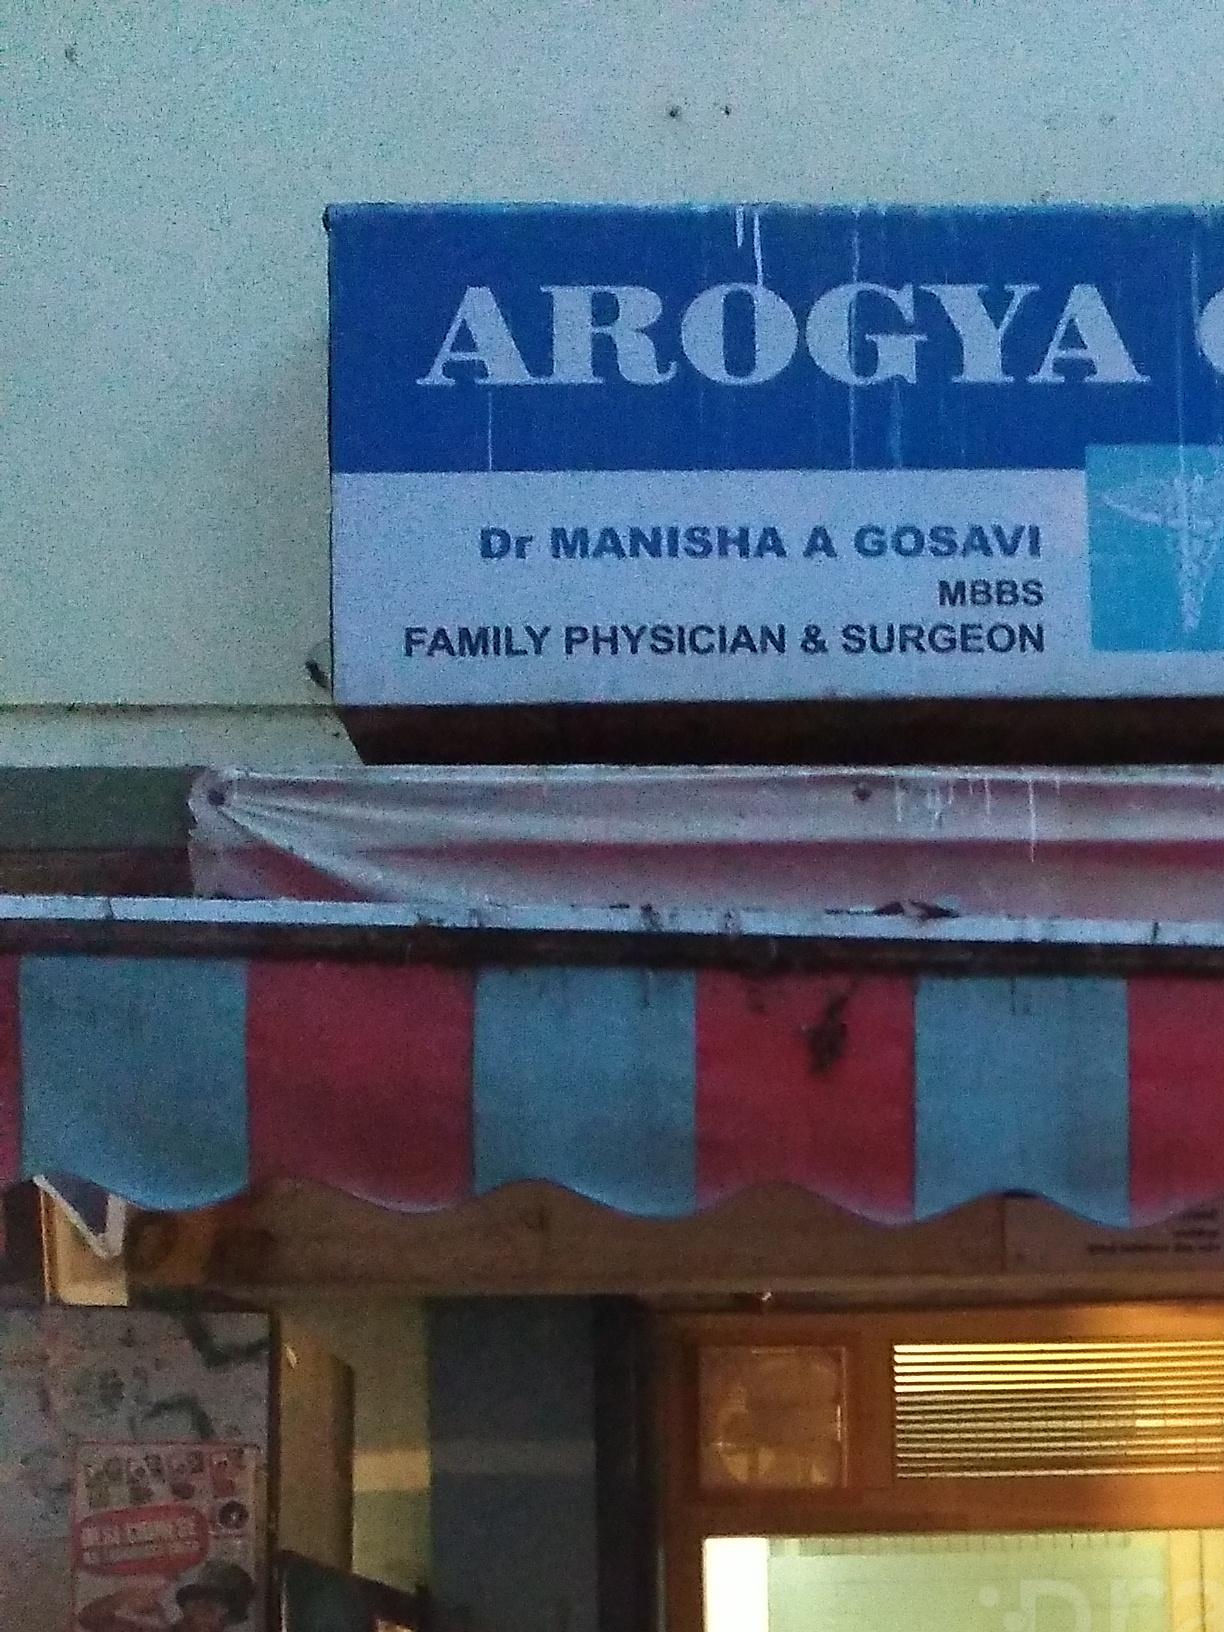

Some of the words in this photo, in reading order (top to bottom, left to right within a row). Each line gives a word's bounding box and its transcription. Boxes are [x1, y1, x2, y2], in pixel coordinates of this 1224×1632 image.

[416, 282, 1151, 387] AROGYA
[481, 527, 533, 562] Dr
[552, 526, 786, 559] MANISHA
[805, 525, 834, 558] A
[854, 524, 1041, 559] GOSAVI
[938, 579, 1043, 608] MBBS
[404, 627, 550, 658] FAMILY
[565, 625, 786, 656] PHYSICIAN
[801, 624, 828, 654] &
[841, 622, 1044, 654] SURGEON
